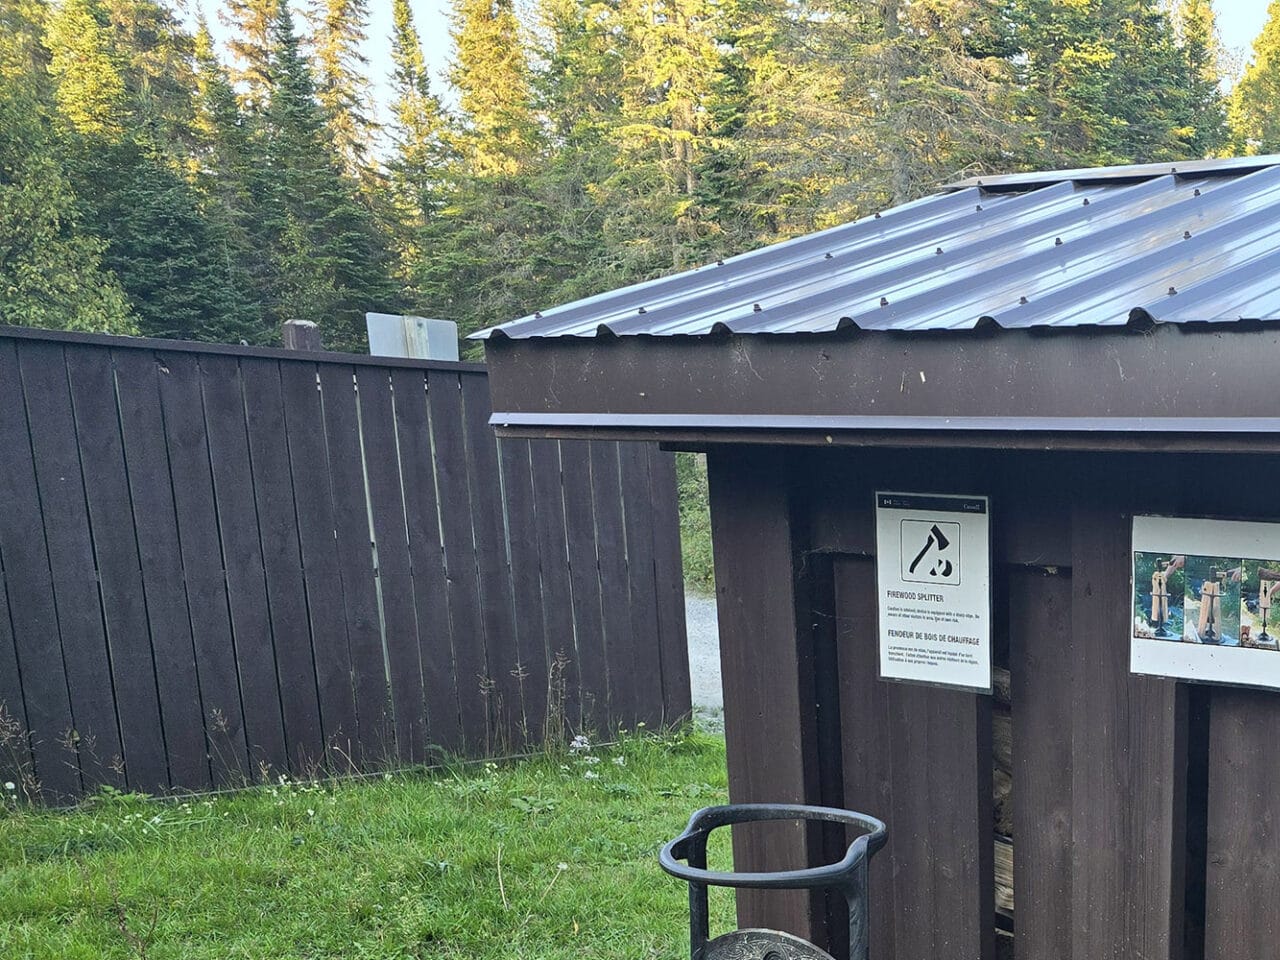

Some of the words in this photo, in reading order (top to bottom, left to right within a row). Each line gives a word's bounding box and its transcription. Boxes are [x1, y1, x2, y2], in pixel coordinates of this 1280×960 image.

[887, 590, 917, 600] FIREWOOD
[917, 592, 944, 602] SPLITTER
[887, 629, 914, 639] FENDEUR
[915, 631, 923, 640] DE
[924, 632, 938, 641] BOIS
[939, 634, 946, 642] DE
[947, 635, 980, 646] CHAUFFAGE
